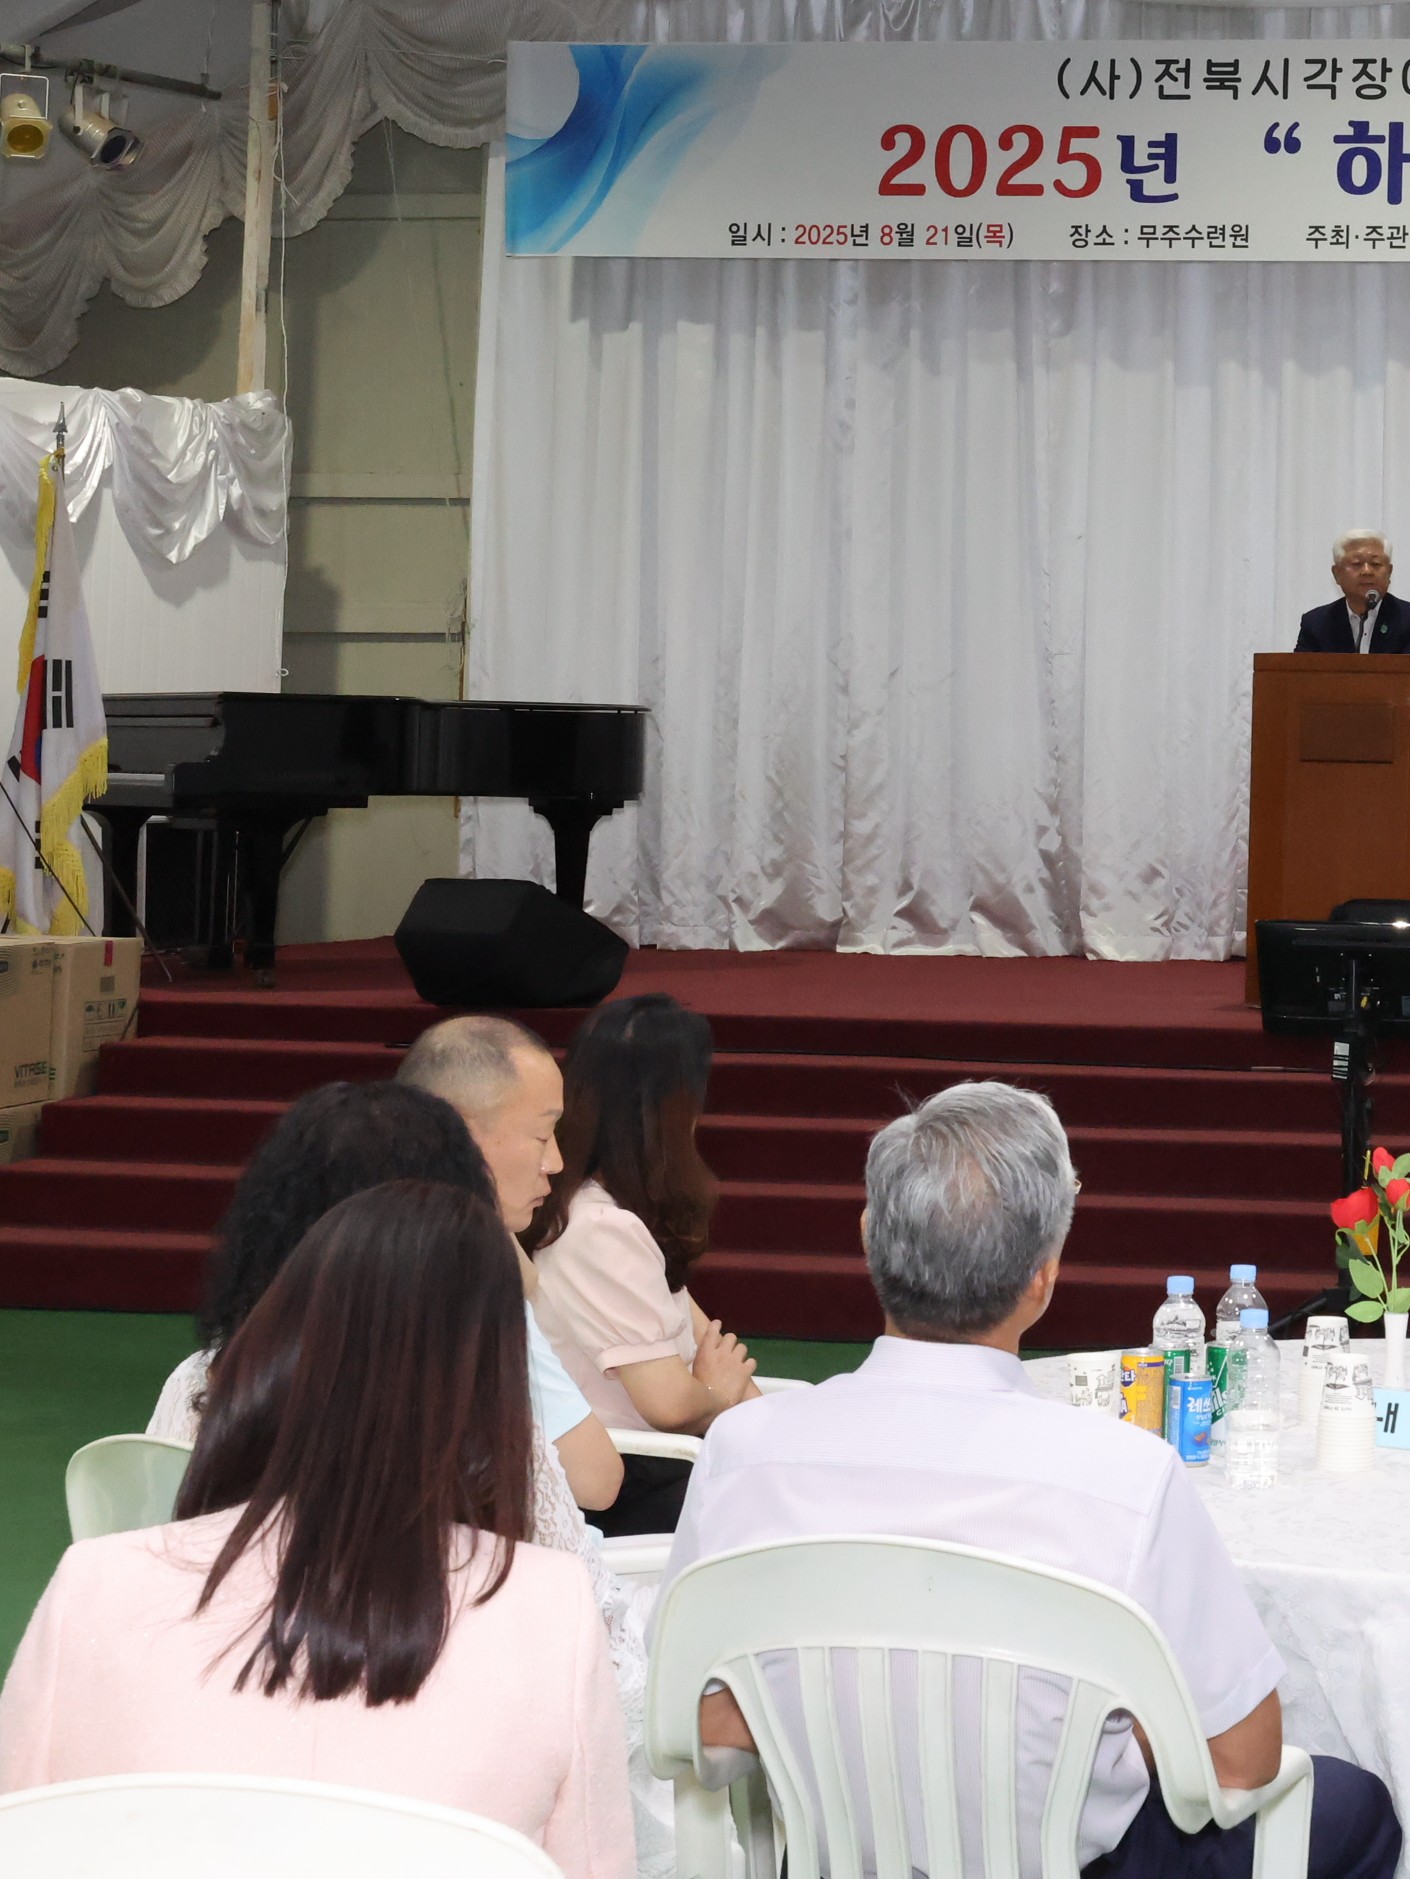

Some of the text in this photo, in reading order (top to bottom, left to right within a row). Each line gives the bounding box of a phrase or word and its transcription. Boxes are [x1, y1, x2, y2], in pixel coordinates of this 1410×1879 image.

[879, 124, 1178, 203] 2025년
[729, 223, 771, 246] 일시
[795, 223, 868, 246] 2025년
[881, 223, 914, 247] 8월
[926, 223, 1013, 248] 21일(목)
[1070, 224, 1114, 248] 장소
[1138, 224, 1248, 248] 무주수련원
